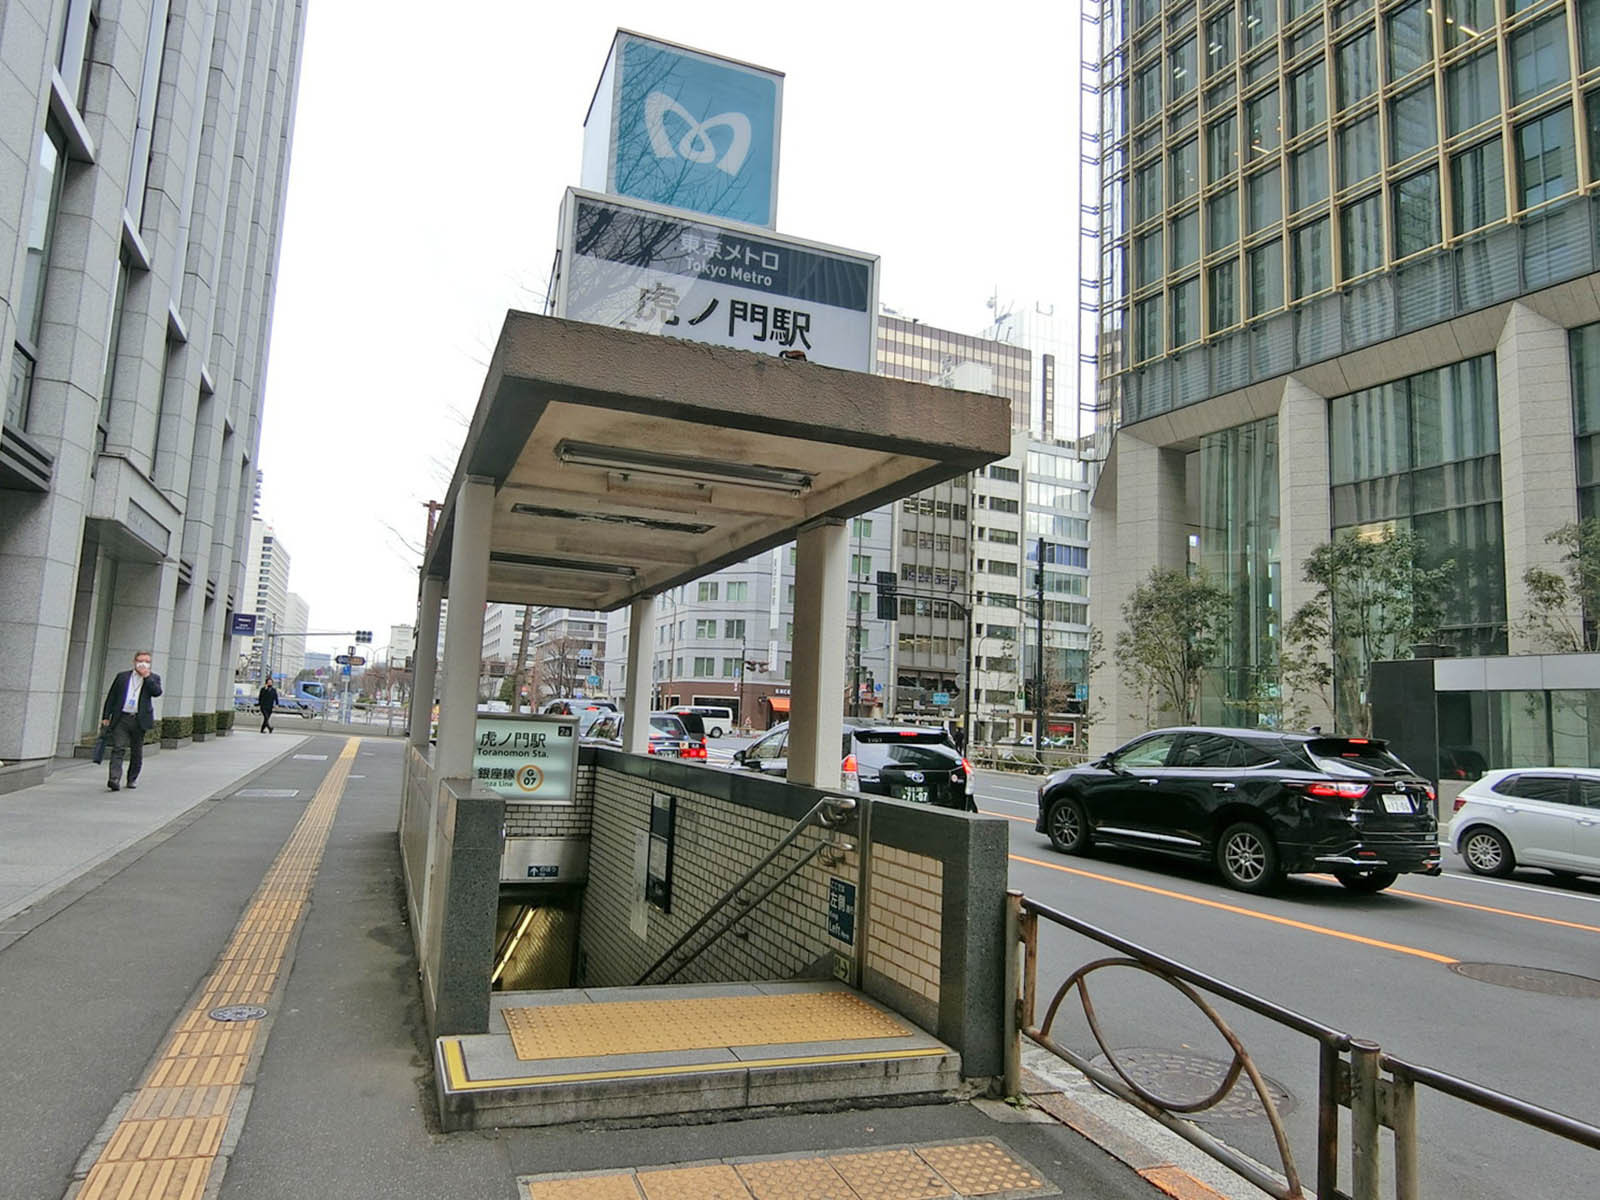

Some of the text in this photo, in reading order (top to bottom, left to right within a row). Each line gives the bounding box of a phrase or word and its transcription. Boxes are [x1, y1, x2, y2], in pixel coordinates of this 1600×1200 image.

[679, 234, 780, 272] 東京メトロ
[686, 256, 773, 288] Tokyo Metro
[636, 282, 812, 350] 虎ノ門駅
[480, 730, 547, 749] 虎ノ門駅
[477, 748, 549, 759] Toranomon Sta.
[478, 767, 516, 780] 銀座線
[526, 768, 535, 777] G
[498, 780, 514, 788] Line
[523, 777, 537, 786] 07
